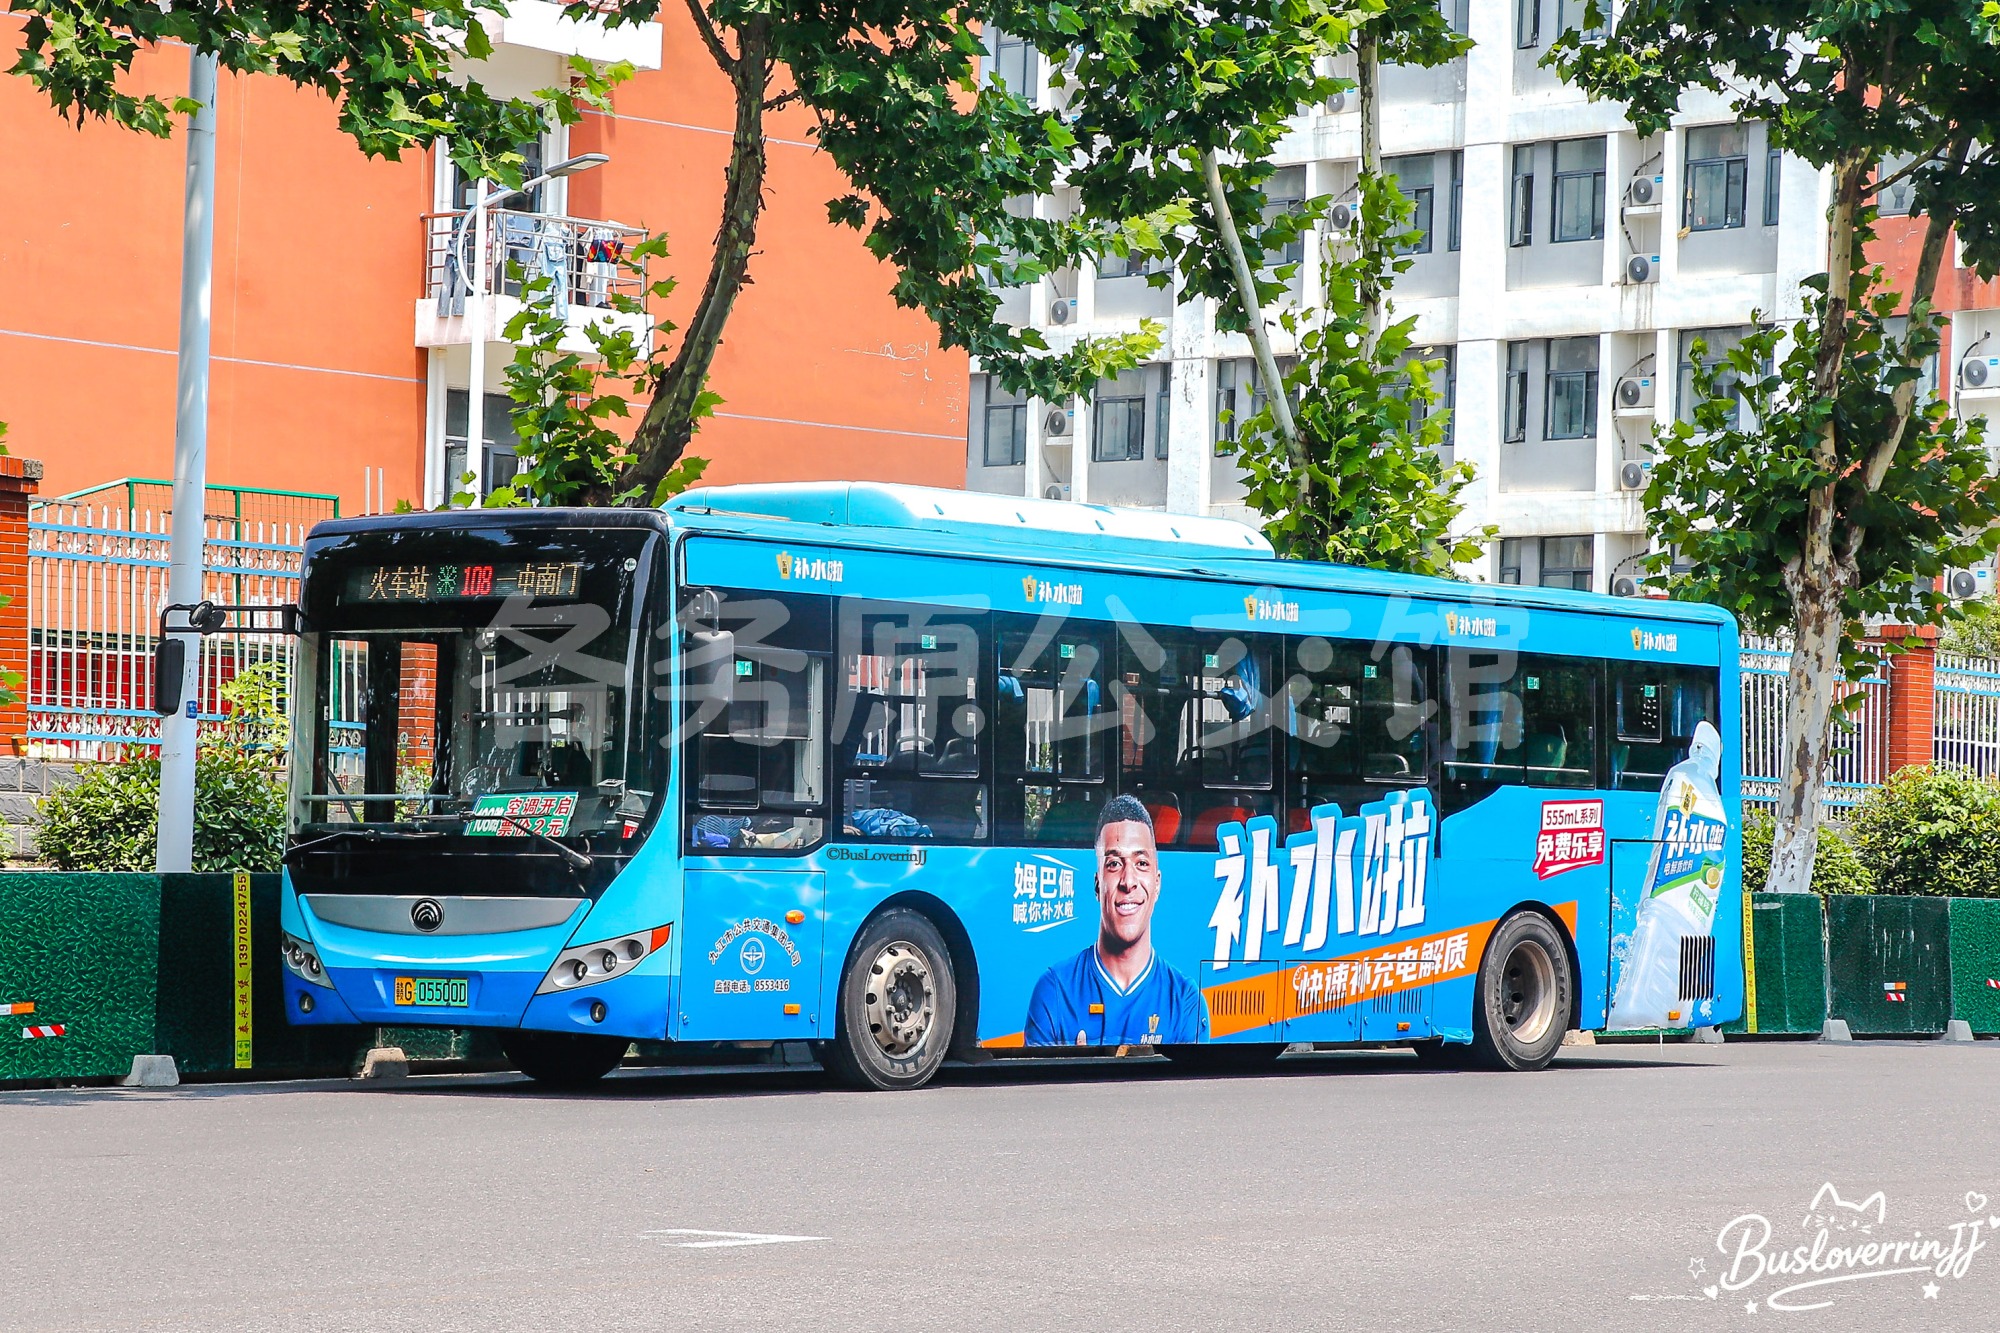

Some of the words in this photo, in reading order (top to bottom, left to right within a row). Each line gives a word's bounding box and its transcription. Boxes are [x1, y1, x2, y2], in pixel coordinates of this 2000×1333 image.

[368, 566, 431, 599] 火车站
[460, 566, 493, 595] 108
[497, 562, 579, 596] 一中南门
[794, 557, 843, 582] 补水啦
[1038, 581, 1082, 605] 补水啦
[1258, 599, 1299, 622] 补水啦
[1459, 616, 1497, 637] 补水啦
[1643, 632, 1677, 652] 补水啦
[505, 797, 573, 816] 空调开启
[1546, 807, 1599, 826] 555mL系列
[1665, 813, 1725, 859] 补水啦
[1534, 831, 1603, 869] 免费乐享
[1013, 861, 1075, 899] 姆巴佩
[1663, 860, 1694, 877] 电解质饮料
[1208, 800, 1430, 970] 补水啦
[237, 875, 248, 968] 13970224755
[1013, 901, 1074, 925] 喊你补水啦
[708, 917, 802, 966] 九江市公共交通集团公司
[1297, 932, 1469, 1008] 快速补充电解质
[754, 979, 790, 991] 8553416
